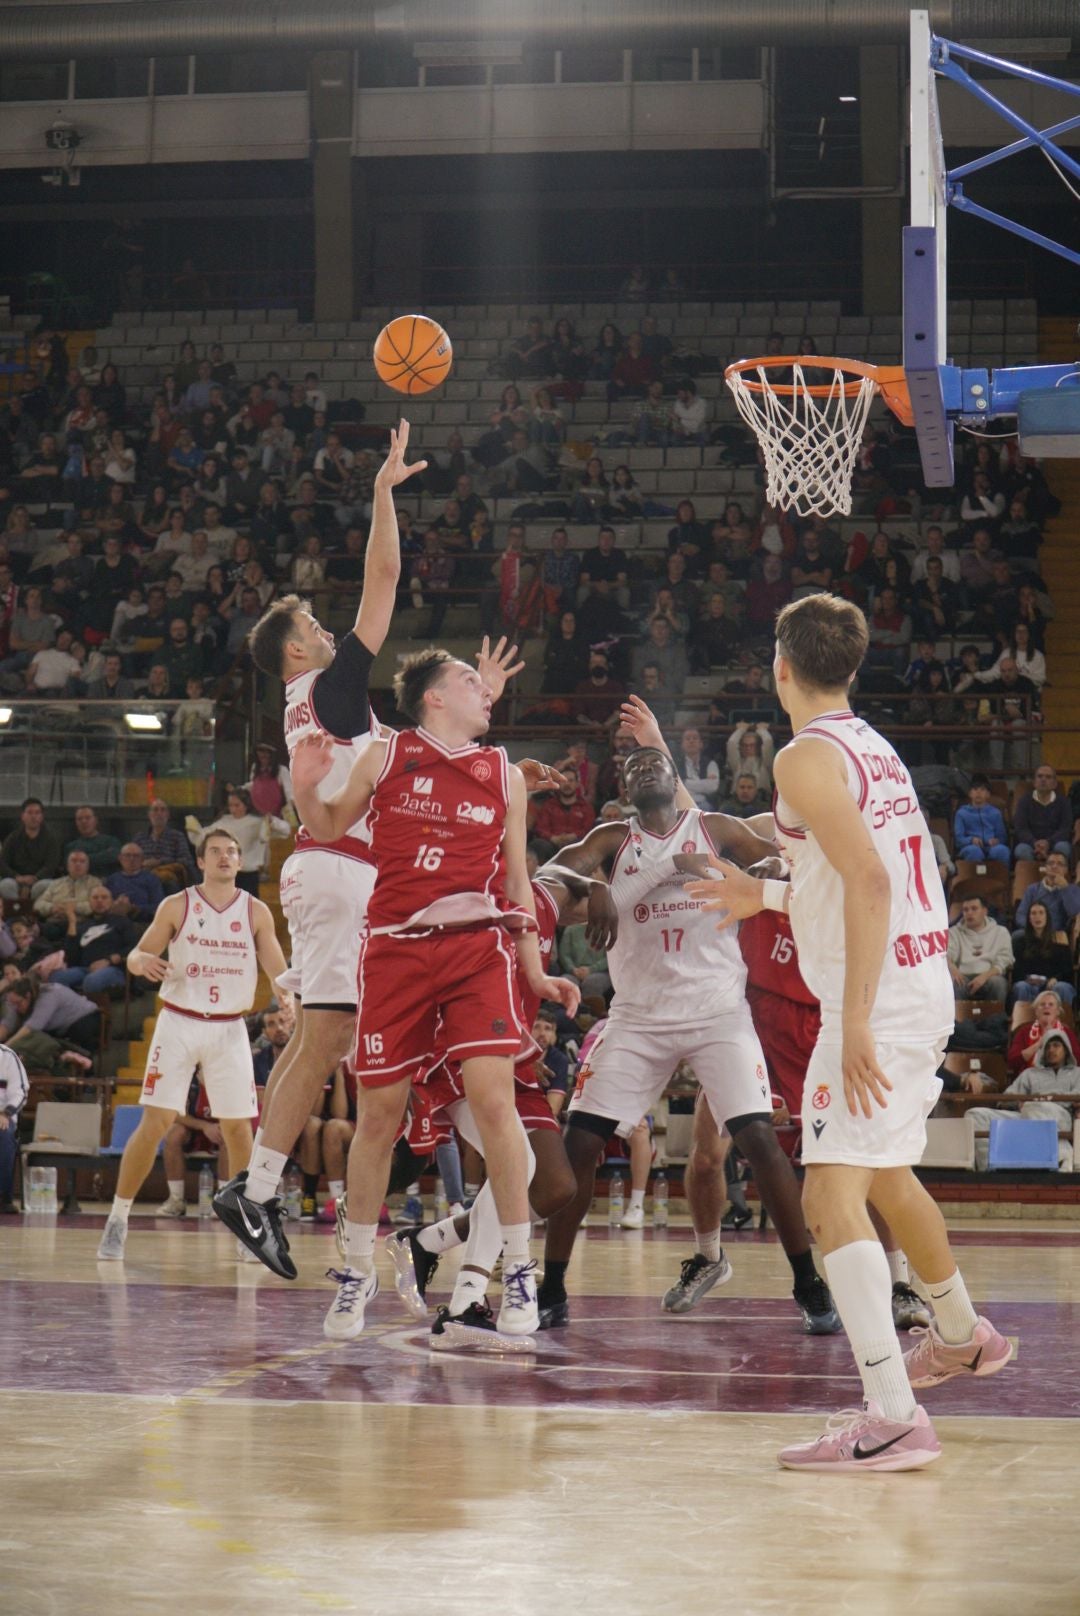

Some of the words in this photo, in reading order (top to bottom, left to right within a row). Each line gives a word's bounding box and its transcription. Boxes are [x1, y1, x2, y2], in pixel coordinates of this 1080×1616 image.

[404, 745, 424, 754] vive
[399, 792, 442, 814] Jaén
[416, 811, 448, 822] INTERIOR
[413, 844, 445, 871] 16
[199, 938, 219, 947] CAJA
[221, 940, 249, 949] RURAL
[661, 928, 684, 953] 17
[770, 933, 794, 964] 15
[202, 965, 244, 976] E.Leclerc
[209, 986, 220, 1004] 5
[363, 1033, 384, 1055] 16
[152, 1046, 161, 1062] 5
[366, 1057, 386, 1065] vive
[421, 1117, 430, 1133] 9
